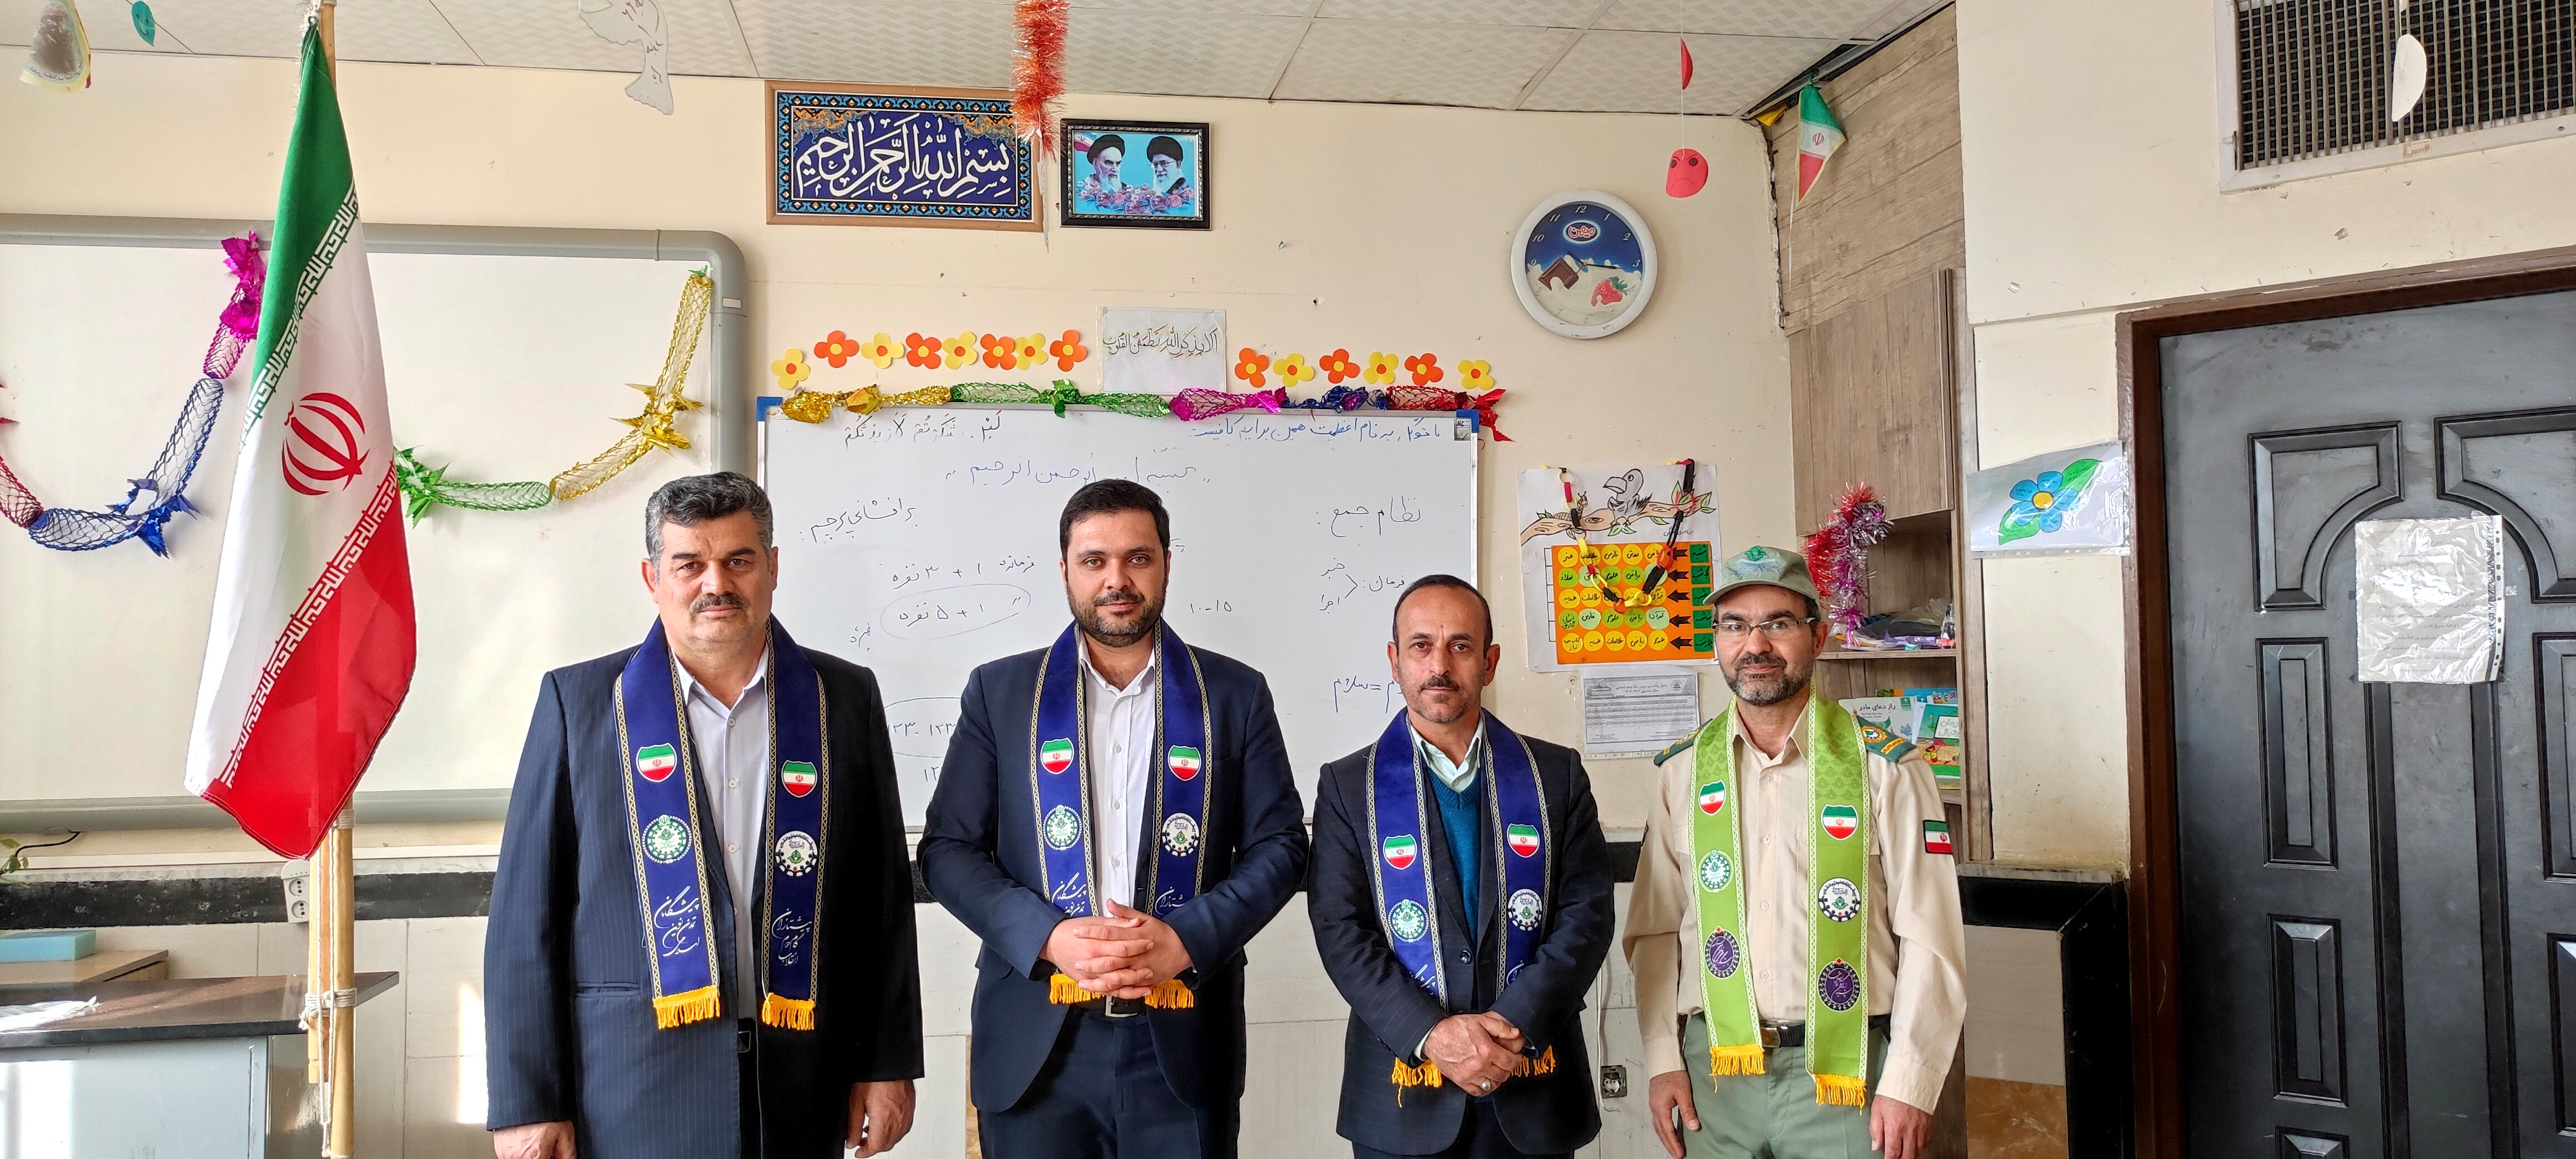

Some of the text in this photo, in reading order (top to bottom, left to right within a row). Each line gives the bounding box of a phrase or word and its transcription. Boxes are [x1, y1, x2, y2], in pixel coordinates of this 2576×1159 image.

[1574, 205, 1587, 214] 12
[1549, 214, 1561, 223] 11
[1604, 213, 1611, 221] 1
[1532, 234, 1545, 243] 10
[1623, 233, 1631, 241] 2
[1633, 259, 1641, 268] 3
[1378, 496, 1421, 536] نظام
[1331, 506, 1369, 538] جمع
[1859, 703, 1871, 712] مادر
